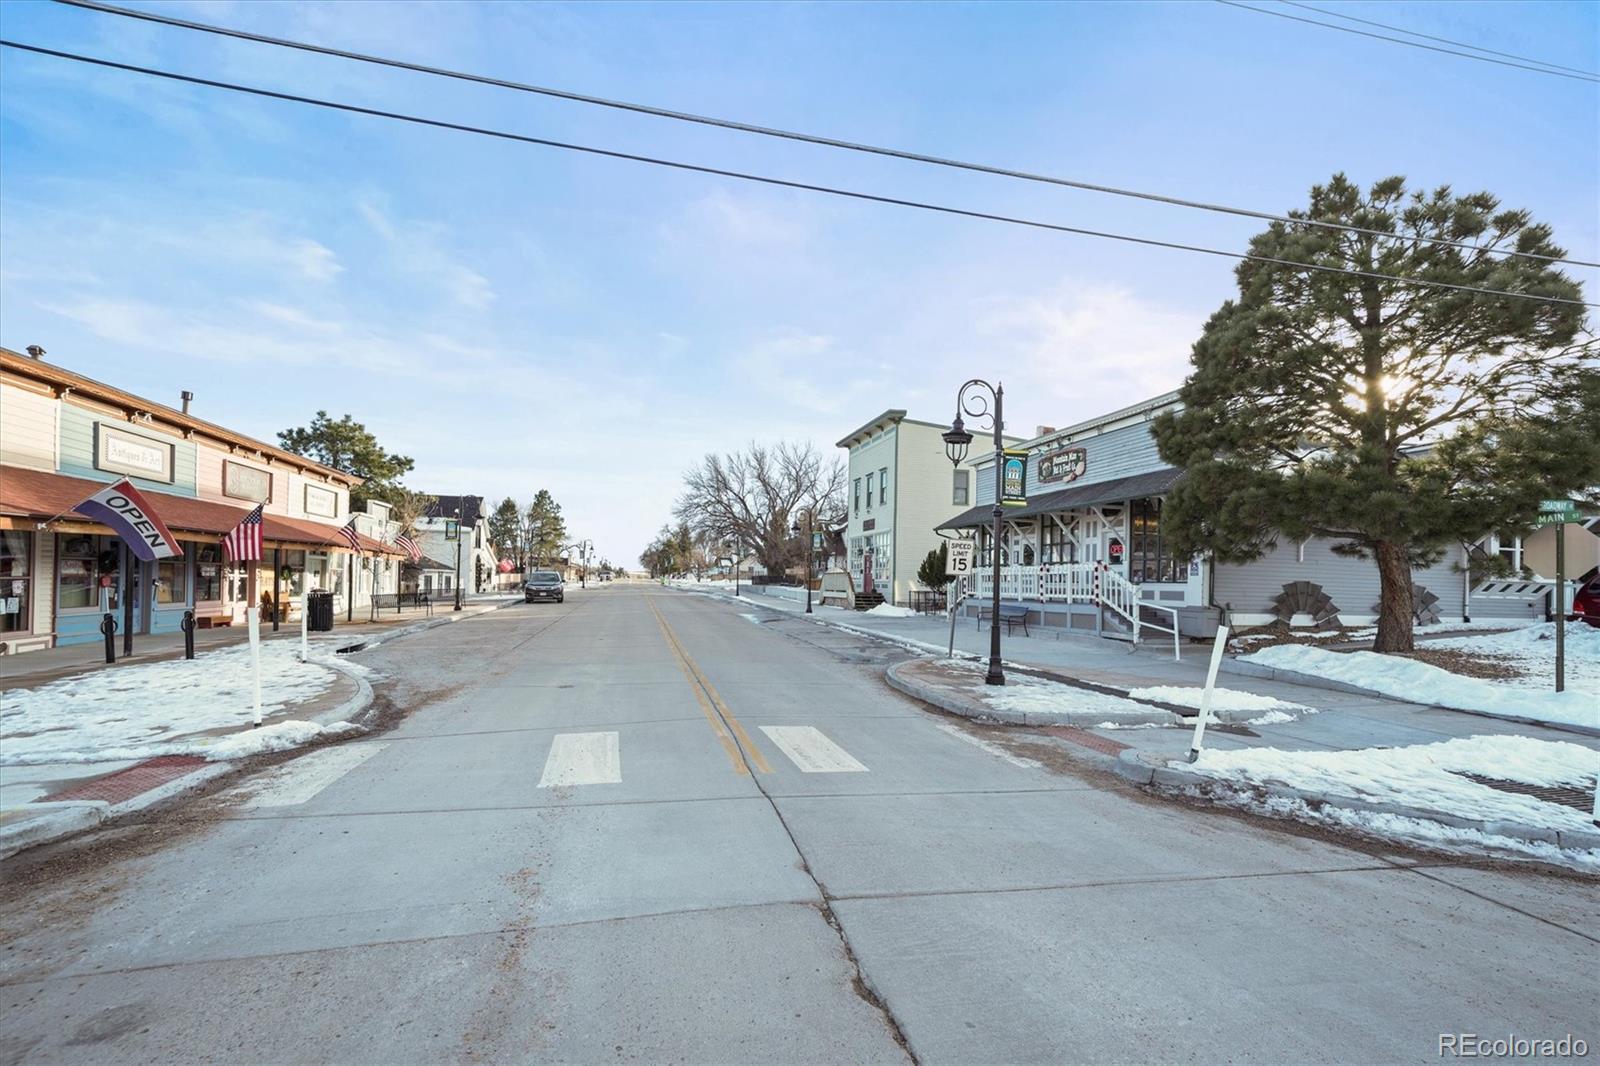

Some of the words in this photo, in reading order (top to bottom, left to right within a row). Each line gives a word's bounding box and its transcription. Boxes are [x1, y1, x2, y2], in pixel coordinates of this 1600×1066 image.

[106, 496, 166, 548] OPEN
[1538, 512, 1565, 523] MAIN
[951, 542, 971, 550] SPEED
[952, 558, 967, 571] 15
